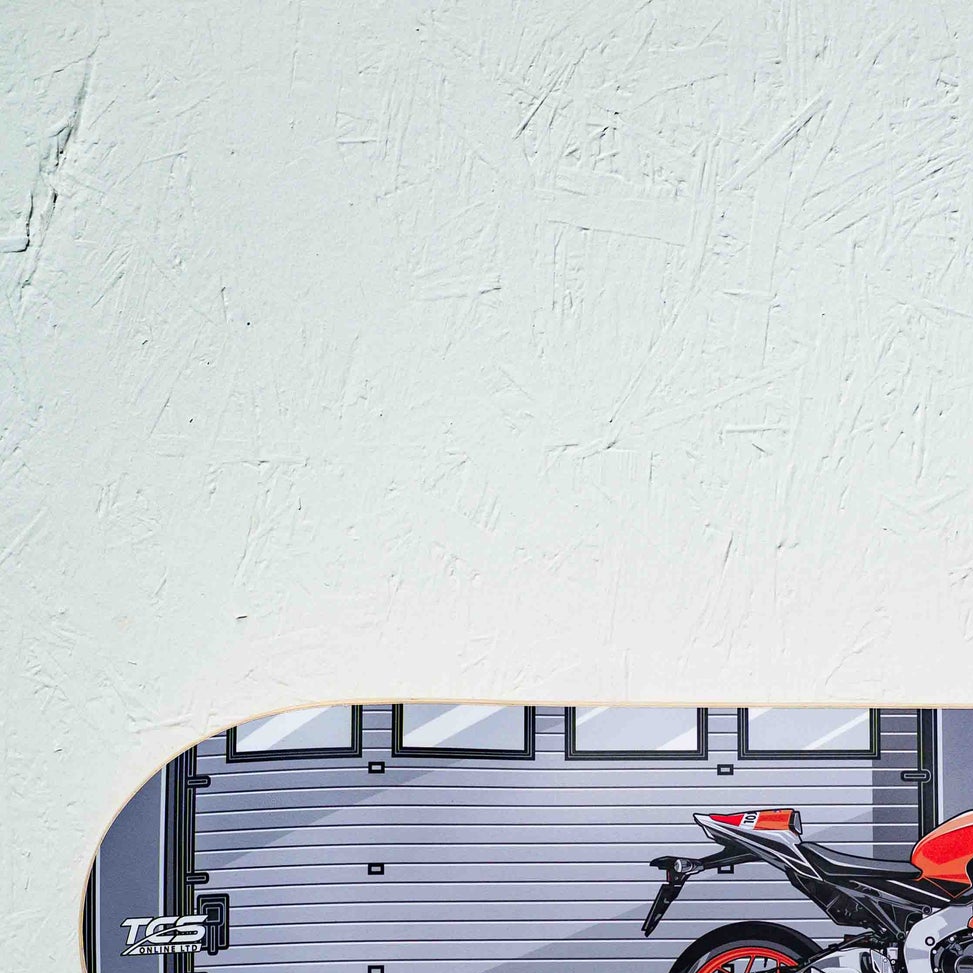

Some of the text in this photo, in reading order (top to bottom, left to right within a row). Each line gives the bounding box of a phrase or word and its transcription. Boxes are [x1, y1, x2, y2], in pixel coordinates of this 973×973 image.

[120, 914, 209, 947] TCS
[139, 944, 199, 954] ONLINE LTD
